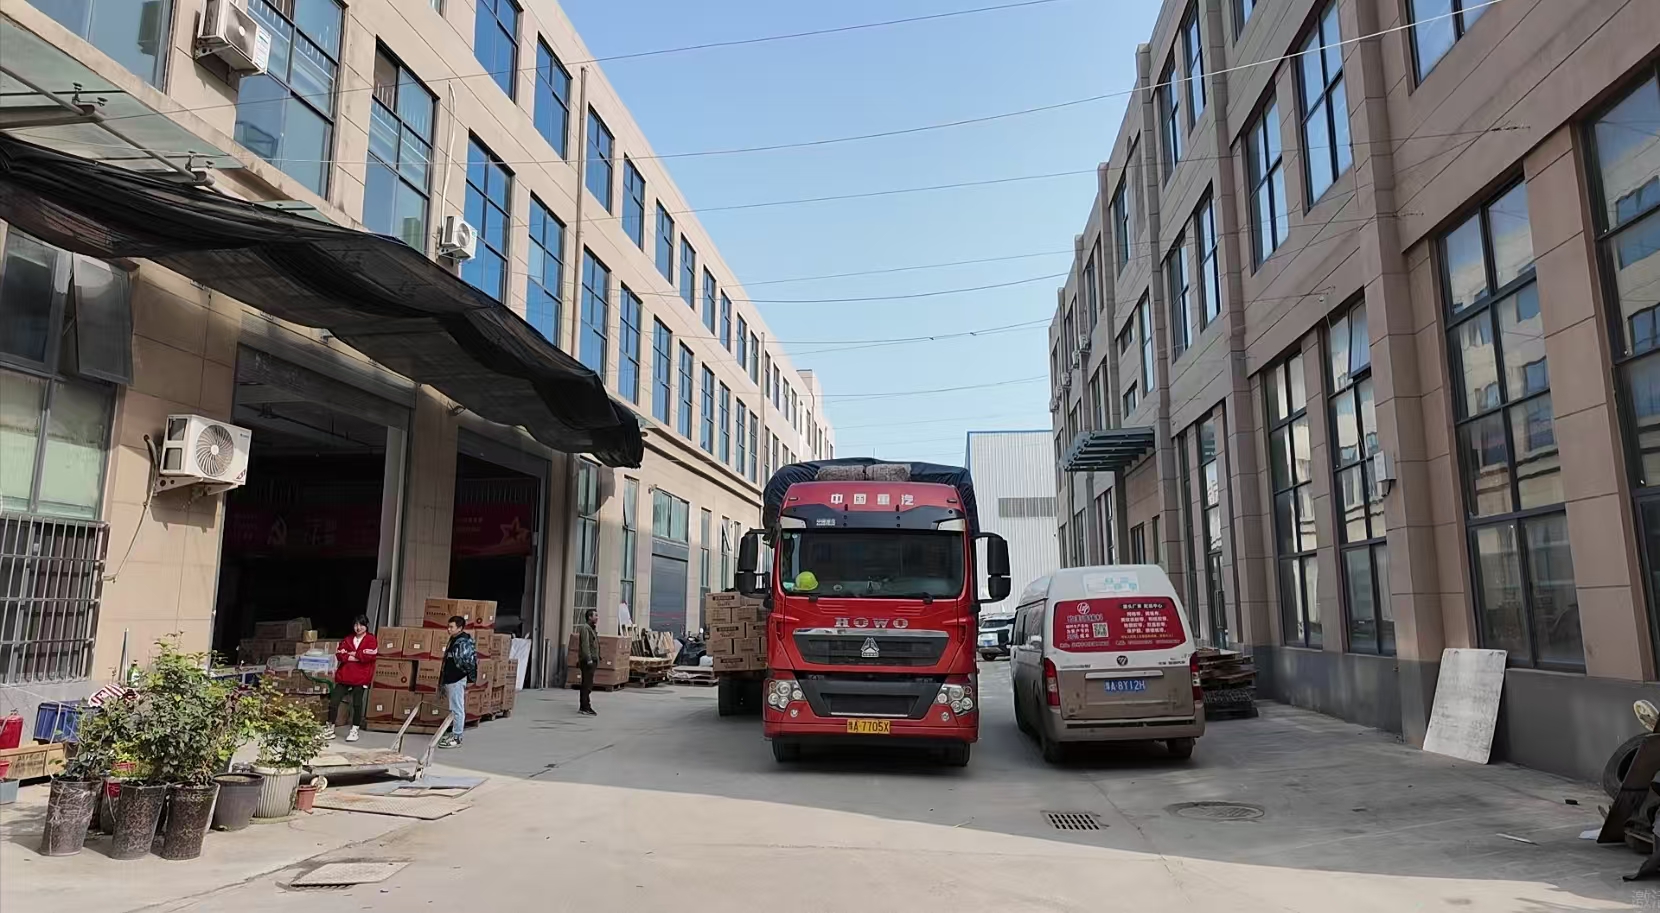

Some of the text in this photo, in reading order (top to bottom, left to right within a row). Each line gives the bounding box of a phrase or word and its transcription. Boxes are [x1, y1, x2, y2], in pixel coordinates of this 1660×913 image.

[831, 493, 914, 506] 中国重汽
[834, 617, 909, 629] HOWO
